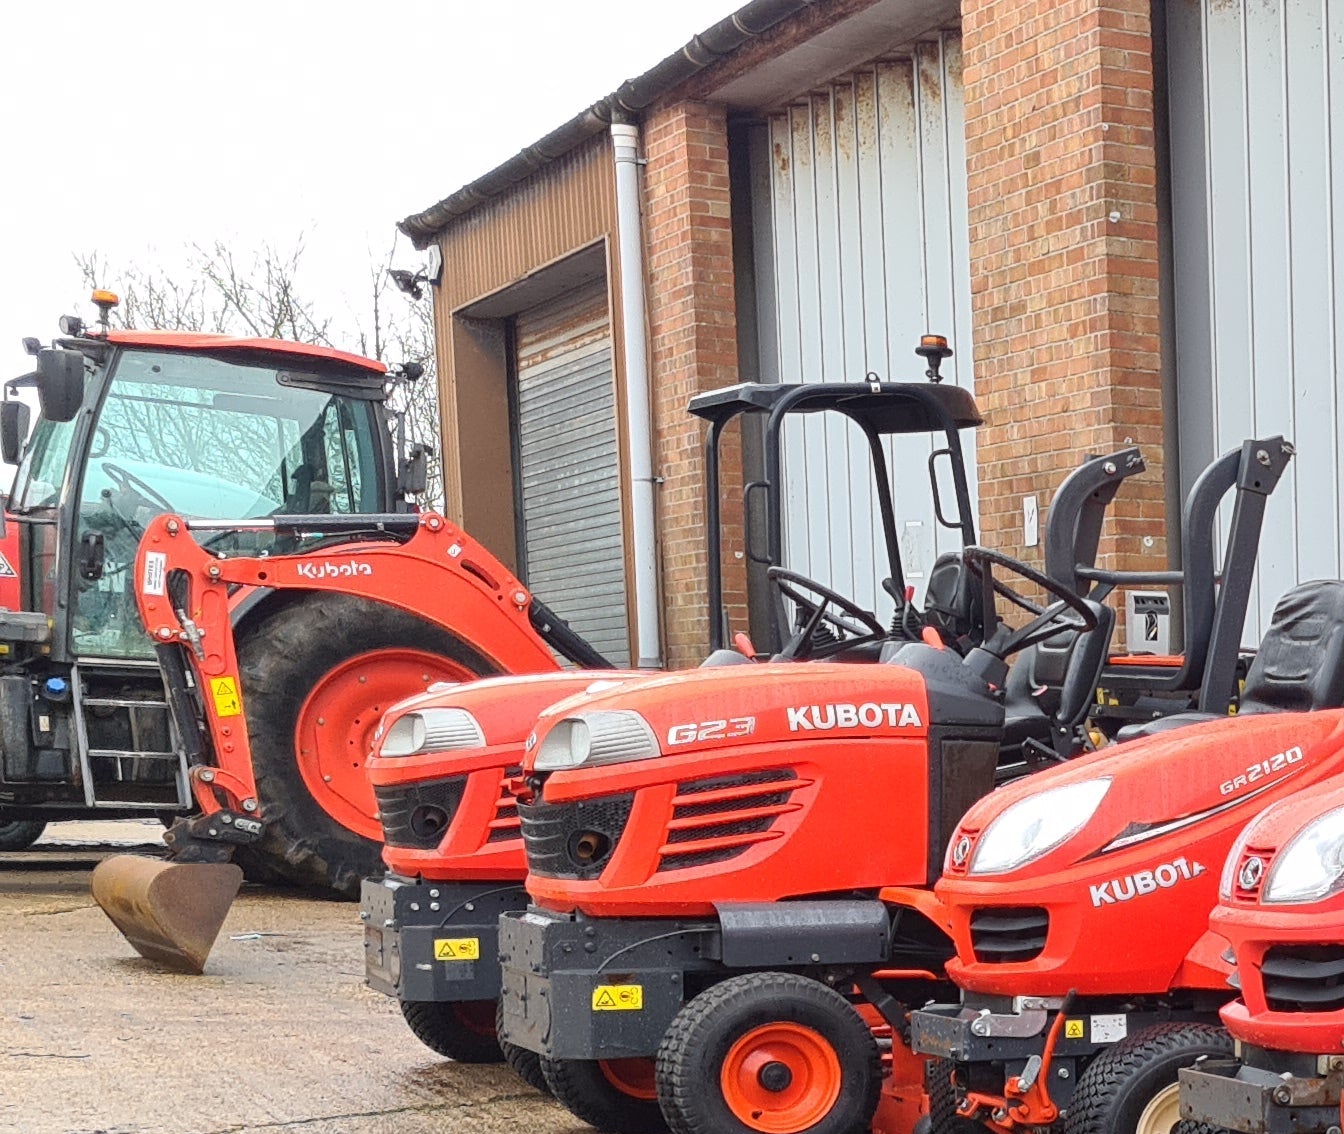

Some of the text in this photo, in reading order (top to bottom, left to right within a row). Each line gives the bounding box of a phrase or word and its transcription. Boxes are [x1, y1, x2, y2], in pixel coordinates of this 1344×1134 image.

[297, 560, 372, 579] Kubota
[667, 702, 922, 746] G23 KUBOTA
[1219, 746, 1304, 796] GR2120
